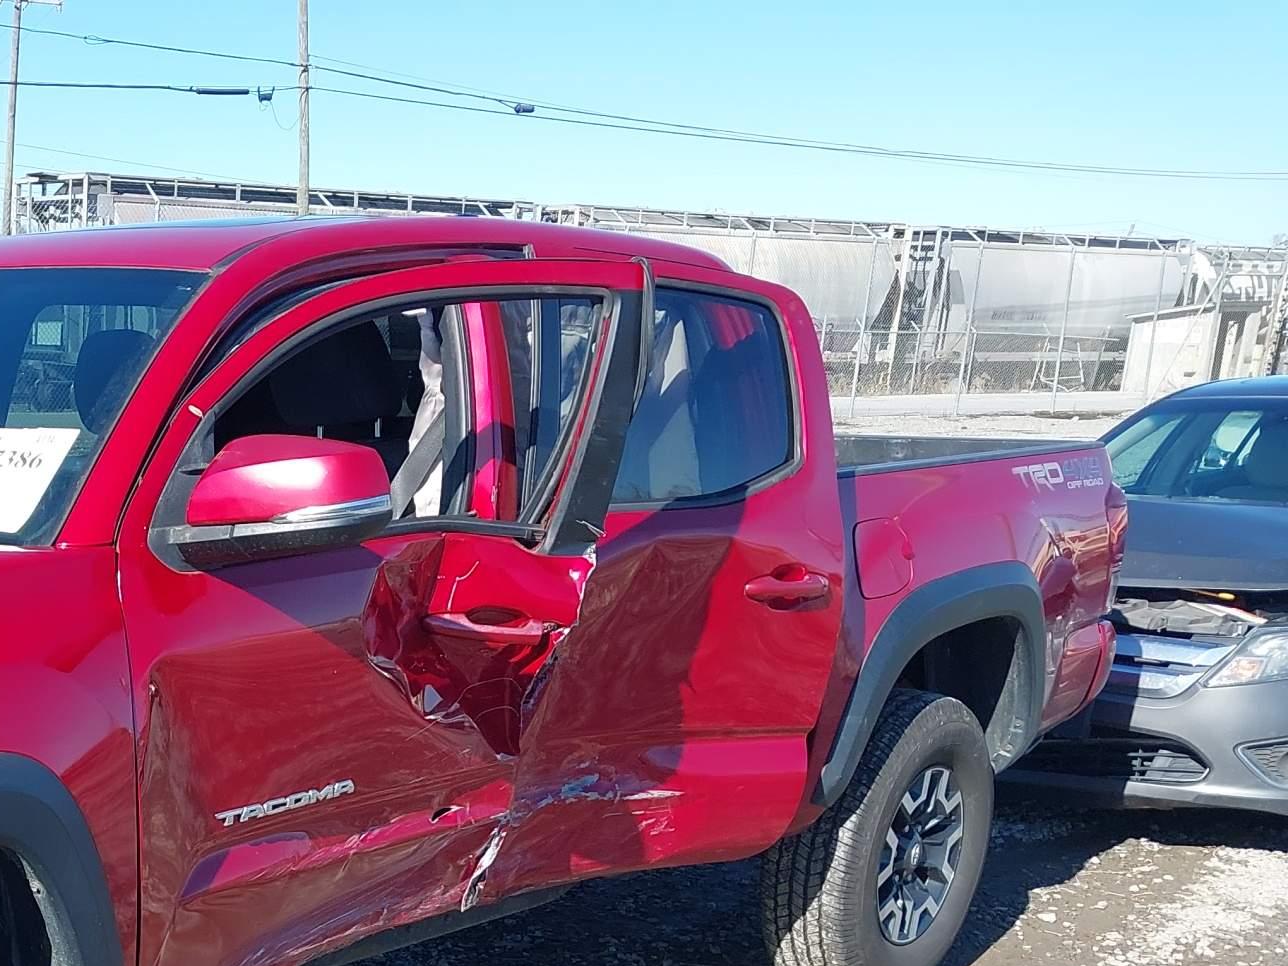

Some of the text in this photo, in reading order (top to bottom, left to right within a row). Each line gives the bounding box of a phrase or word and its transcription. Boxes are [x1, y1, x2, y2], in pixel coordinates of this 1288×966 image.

[1011, 462, 1064, 493] TRD
[1066, 477, 1104, 489] OFF ROAD
[214, 779, 356, 827] TACOMA
